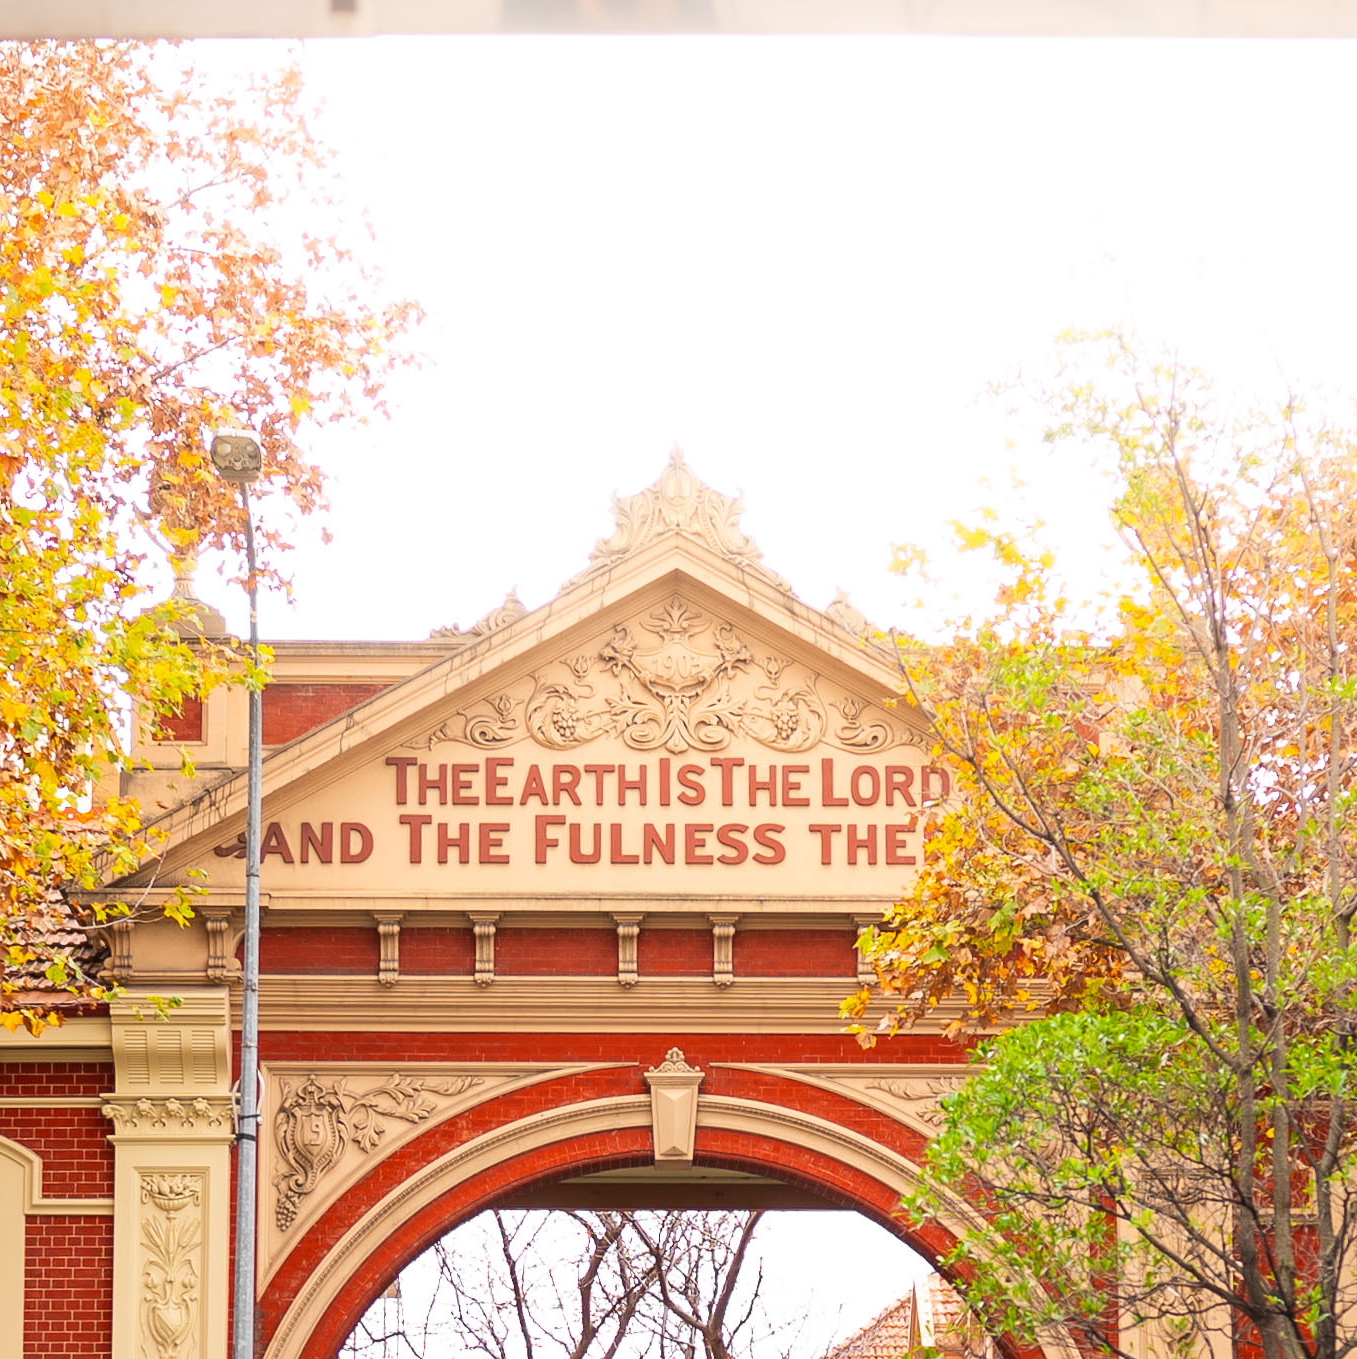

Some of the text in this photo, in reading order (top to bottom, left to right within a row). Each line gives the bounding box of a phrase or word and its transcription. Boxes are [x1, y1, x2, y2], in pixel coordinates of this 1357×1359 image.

[260, 814, 944, 866] AND THE FULNESS THE
